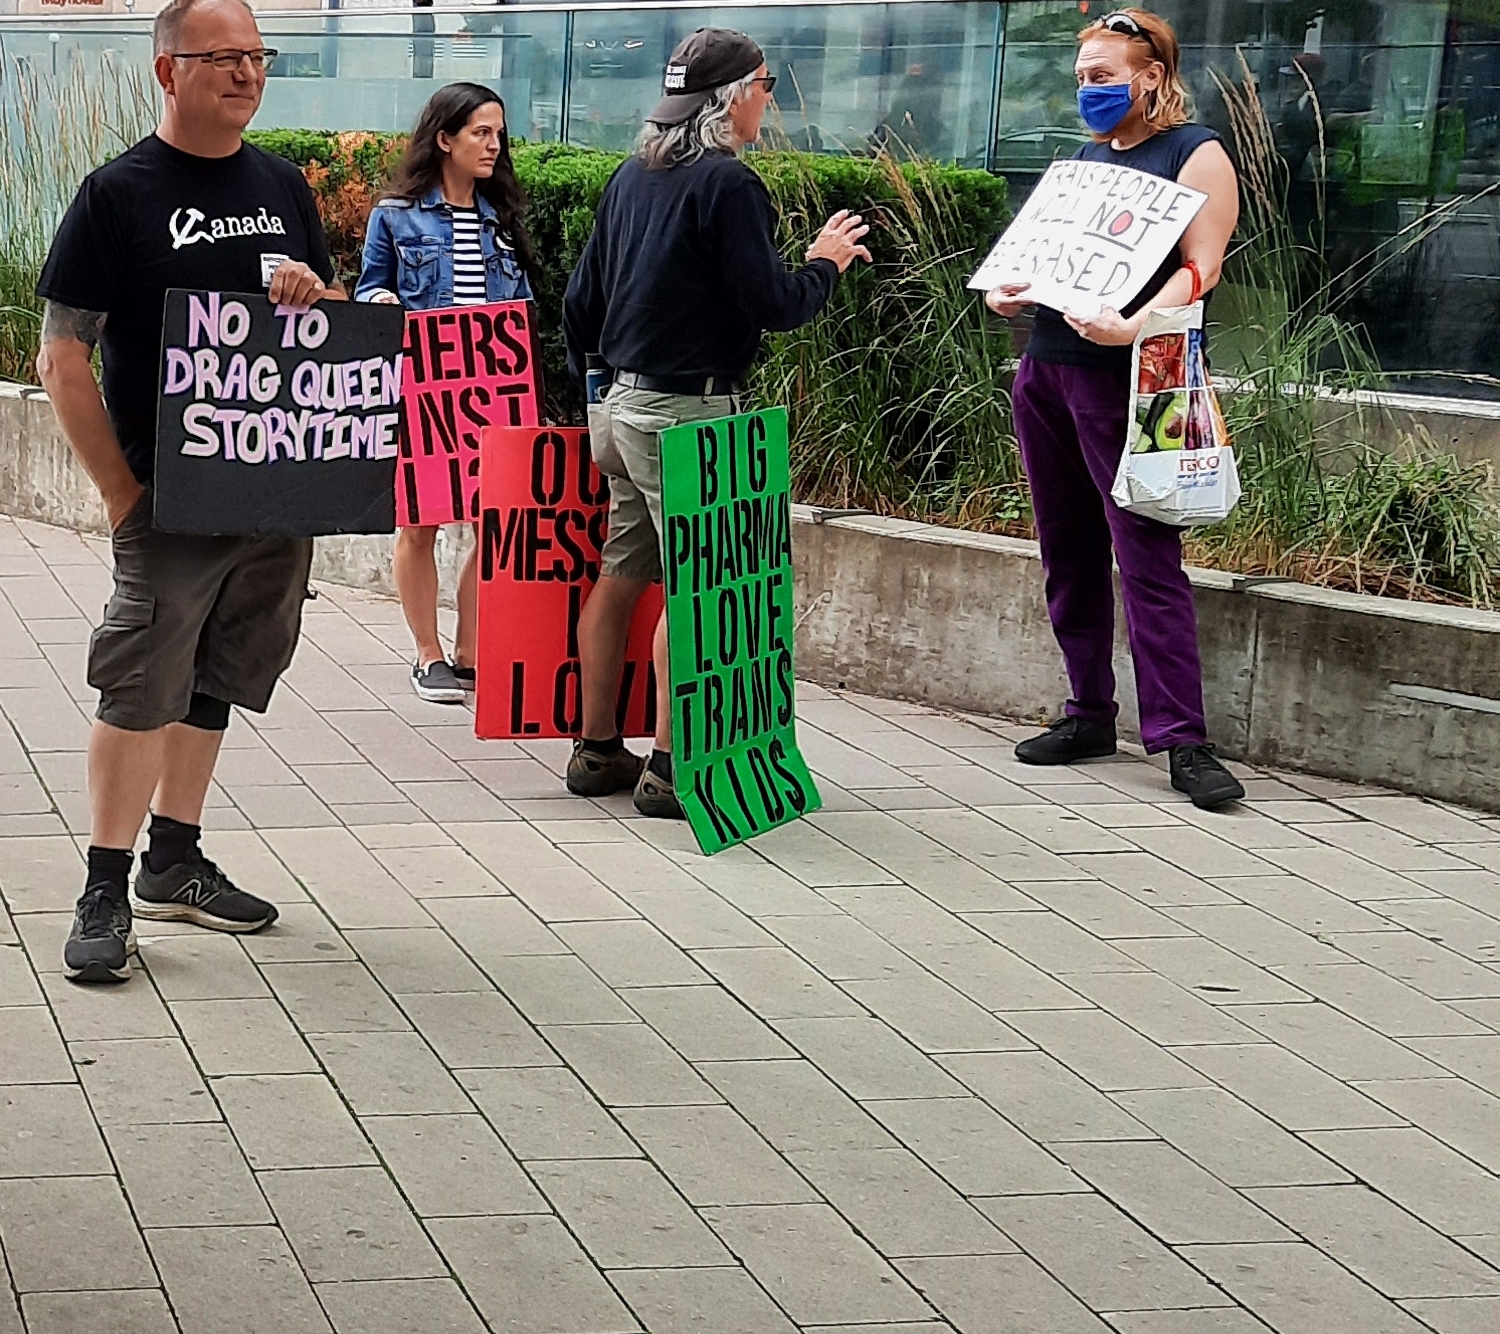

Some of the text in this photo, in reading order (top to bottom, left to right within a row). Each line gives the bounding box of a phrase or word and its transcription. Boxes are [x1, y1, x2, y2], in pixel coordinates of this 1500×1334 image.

[1086, 200, 1160, 247] NOT
[1098, 168, 1193, 223] PEOPLE
[1012, 238, 1132, 297] ERASED
[187, 291, 330, 350] NO TO
[163, 346, 404, 411] DRAG QUEEN
[180, 402, 399, 465] STORYTIME
[696, 414, 768, 507] BIG
[667, 490, 793, 597] PHARMA
[693, 572, 785, 674] LOVE
[675, 648, 793, 763] TRANS
[693, 735, 807, 846] KIDS
